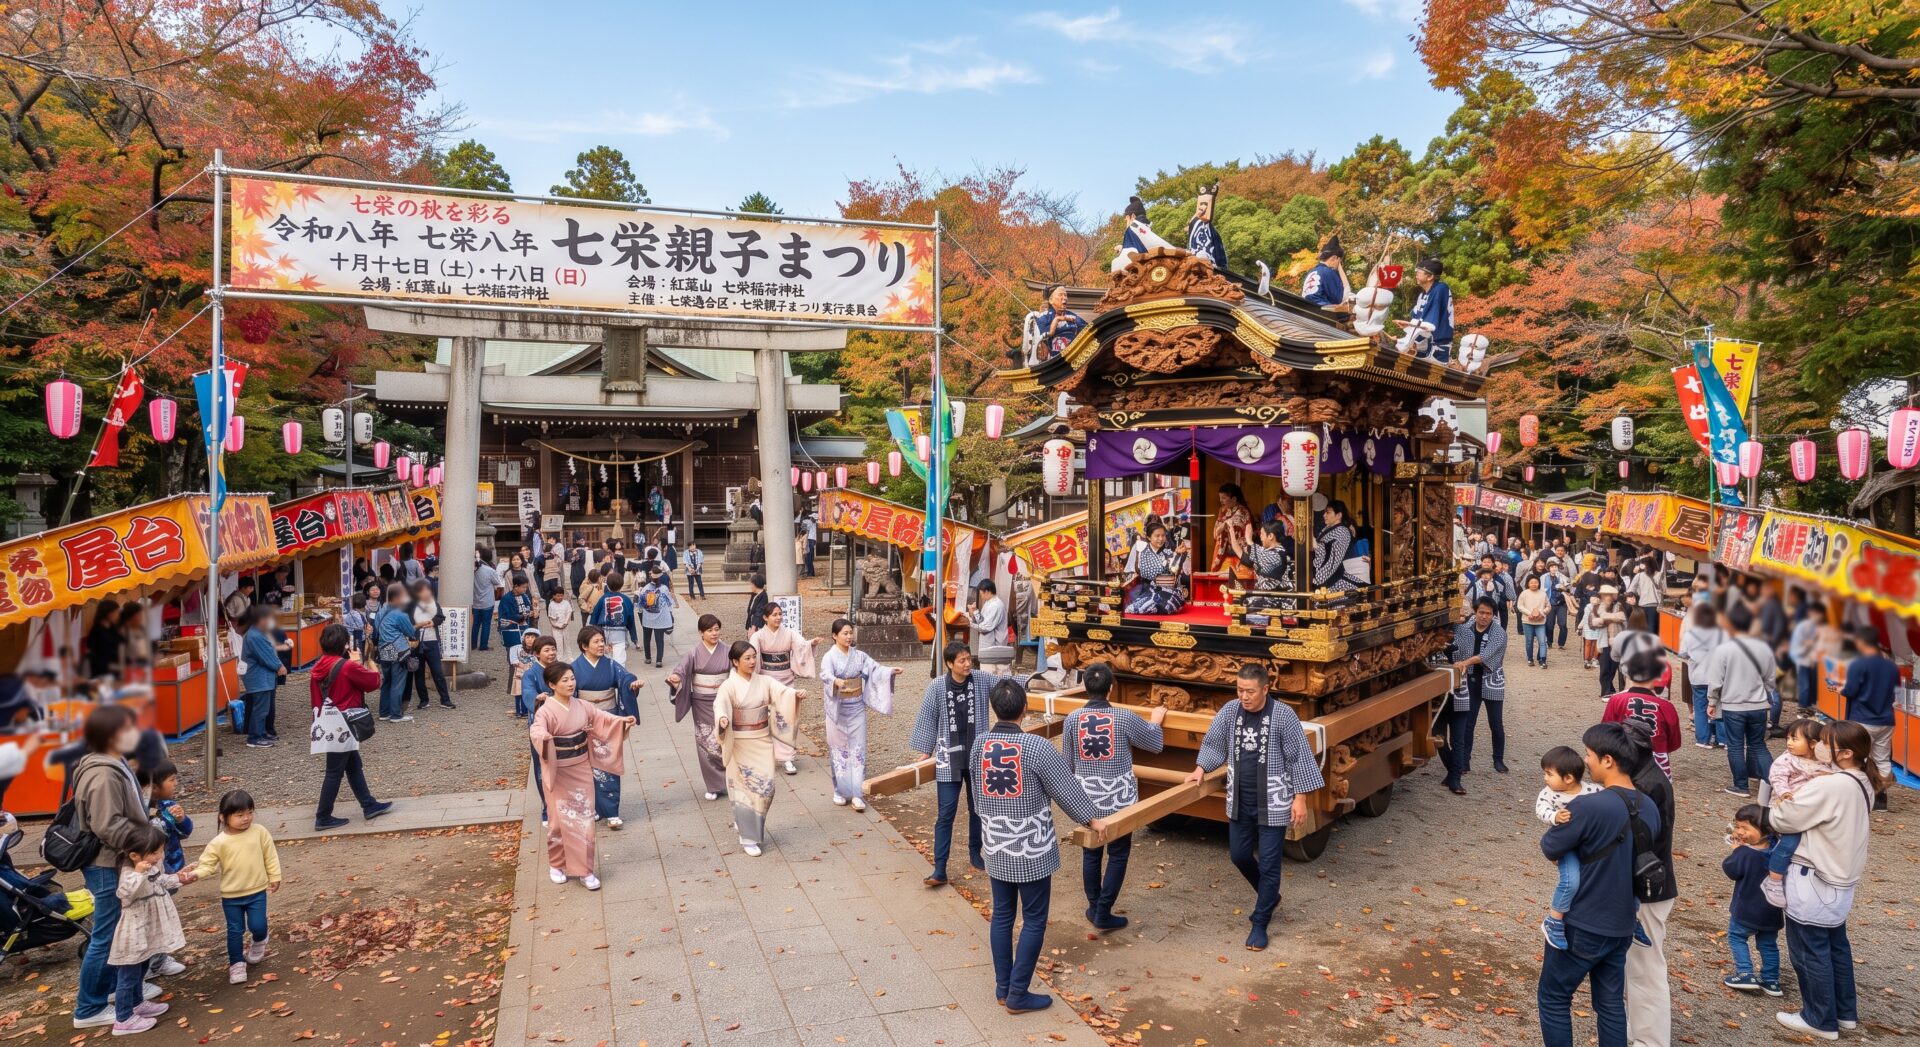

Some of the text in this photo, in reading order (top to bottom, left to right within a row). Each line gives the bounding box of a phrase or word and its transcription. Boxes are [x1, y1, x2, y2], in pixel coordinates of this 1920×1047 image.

[350, 193, 512, 226] 七栄の秋を彩る
[268, 213, 906, 288] 令和八年 七栄八年 七栄親子まつり
[722, 280, 806, 298] 七栄稲荷神社
[273, 508, 327, 549] 屋台
[60, 516, 185, 591] 屋台
